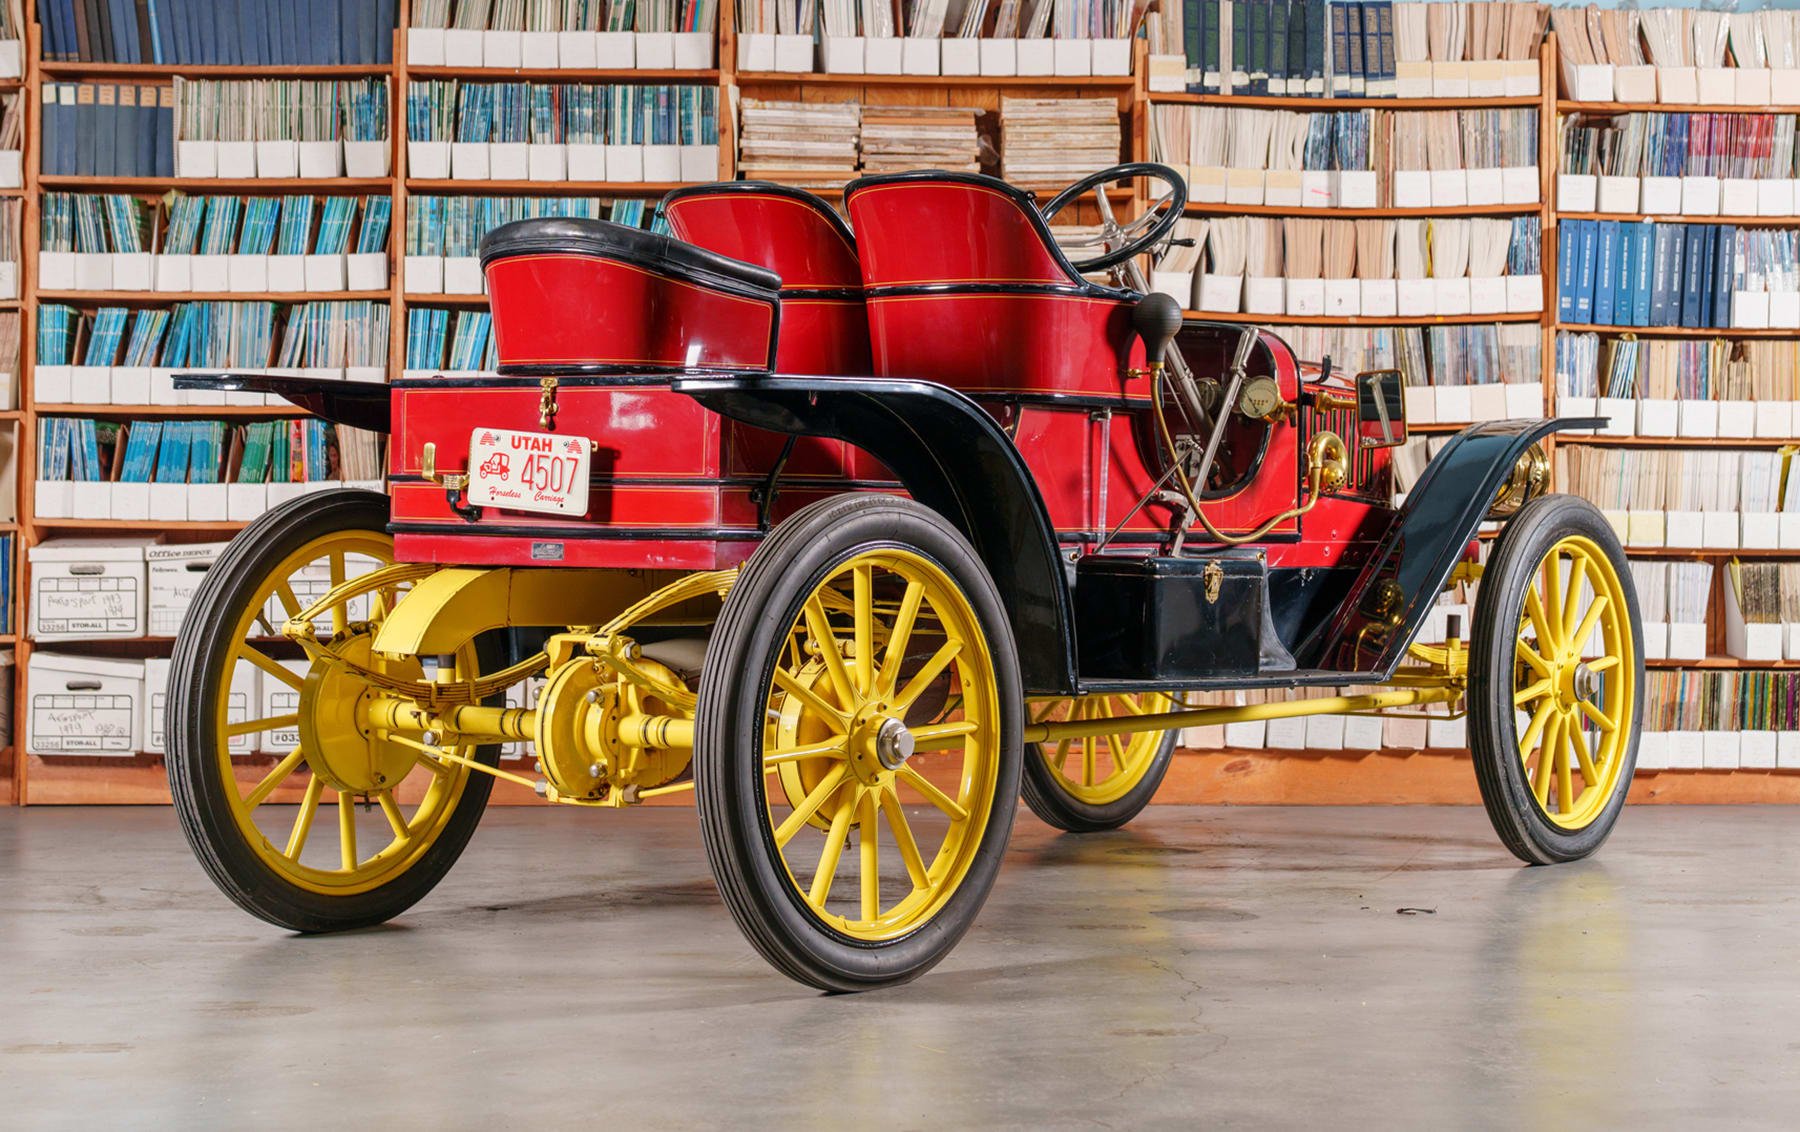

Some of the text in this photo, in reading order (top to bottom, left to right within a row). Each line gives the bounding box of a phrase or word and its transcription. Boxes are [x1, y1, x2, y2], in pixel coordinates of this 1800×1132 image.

[511, 435, 552, 452] UTAH
[521, 454, 579, 494] 4507
[489, 485, 521, 498] Horseless
[534, 490, 565, 503] Carriage
[149, 550, 181, 558] Office
